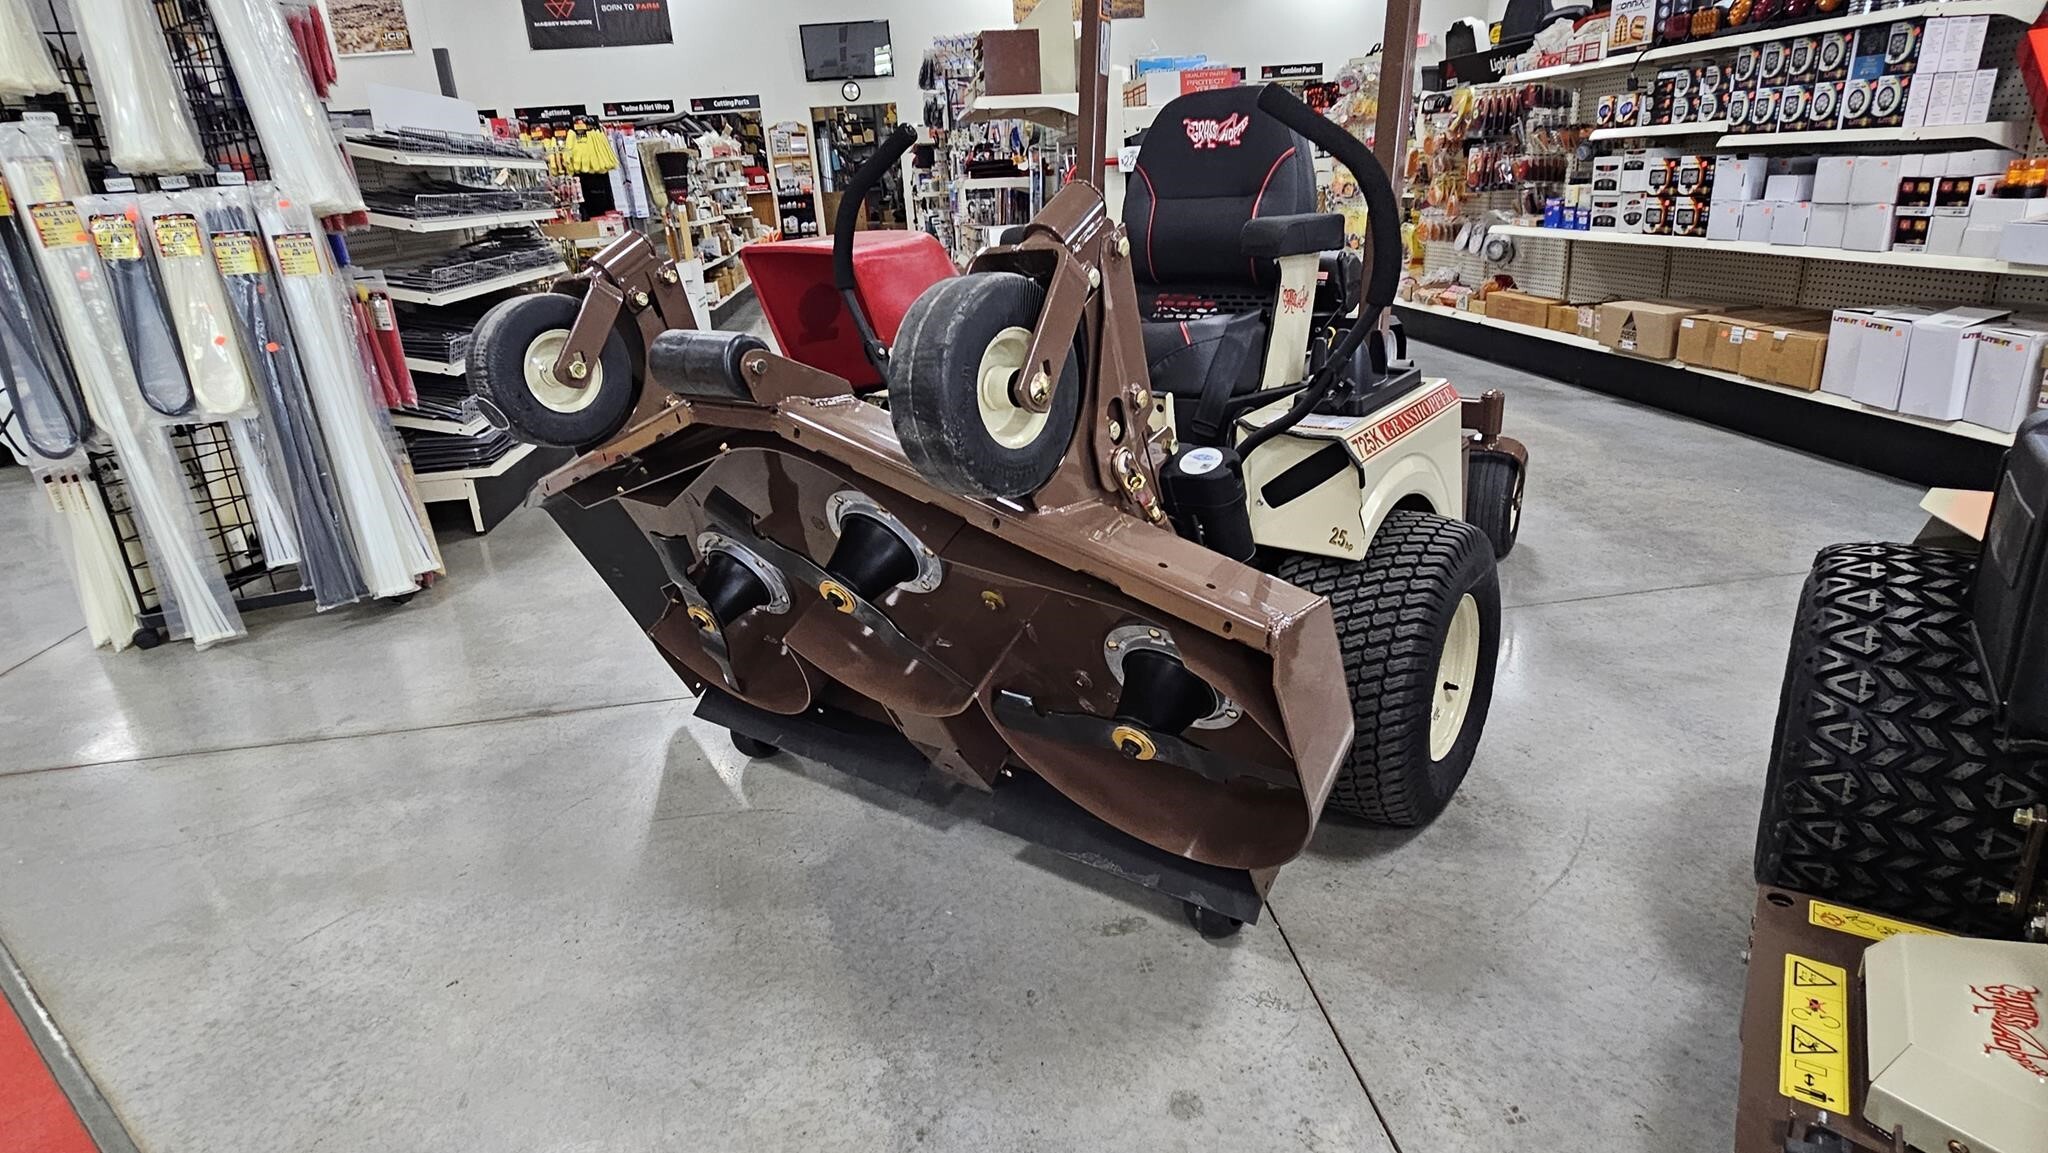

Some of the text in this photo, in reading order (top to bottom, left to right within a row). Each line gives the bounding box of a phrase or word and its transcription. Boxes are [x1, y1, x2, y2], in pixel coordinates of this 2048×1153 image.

[601, 2, 660, 12] BORN TO FARM
[1280, 65, 1316, 75] Combine Parts
[621, 104, 638, 112] Twine
[644, 103, 654, 111] Net
[654, 102, 670, 112] Wrap
[713, 100, 734, 108] Cutting
[1351, 387, 1455, 459] 725K GRASSHOPPER
